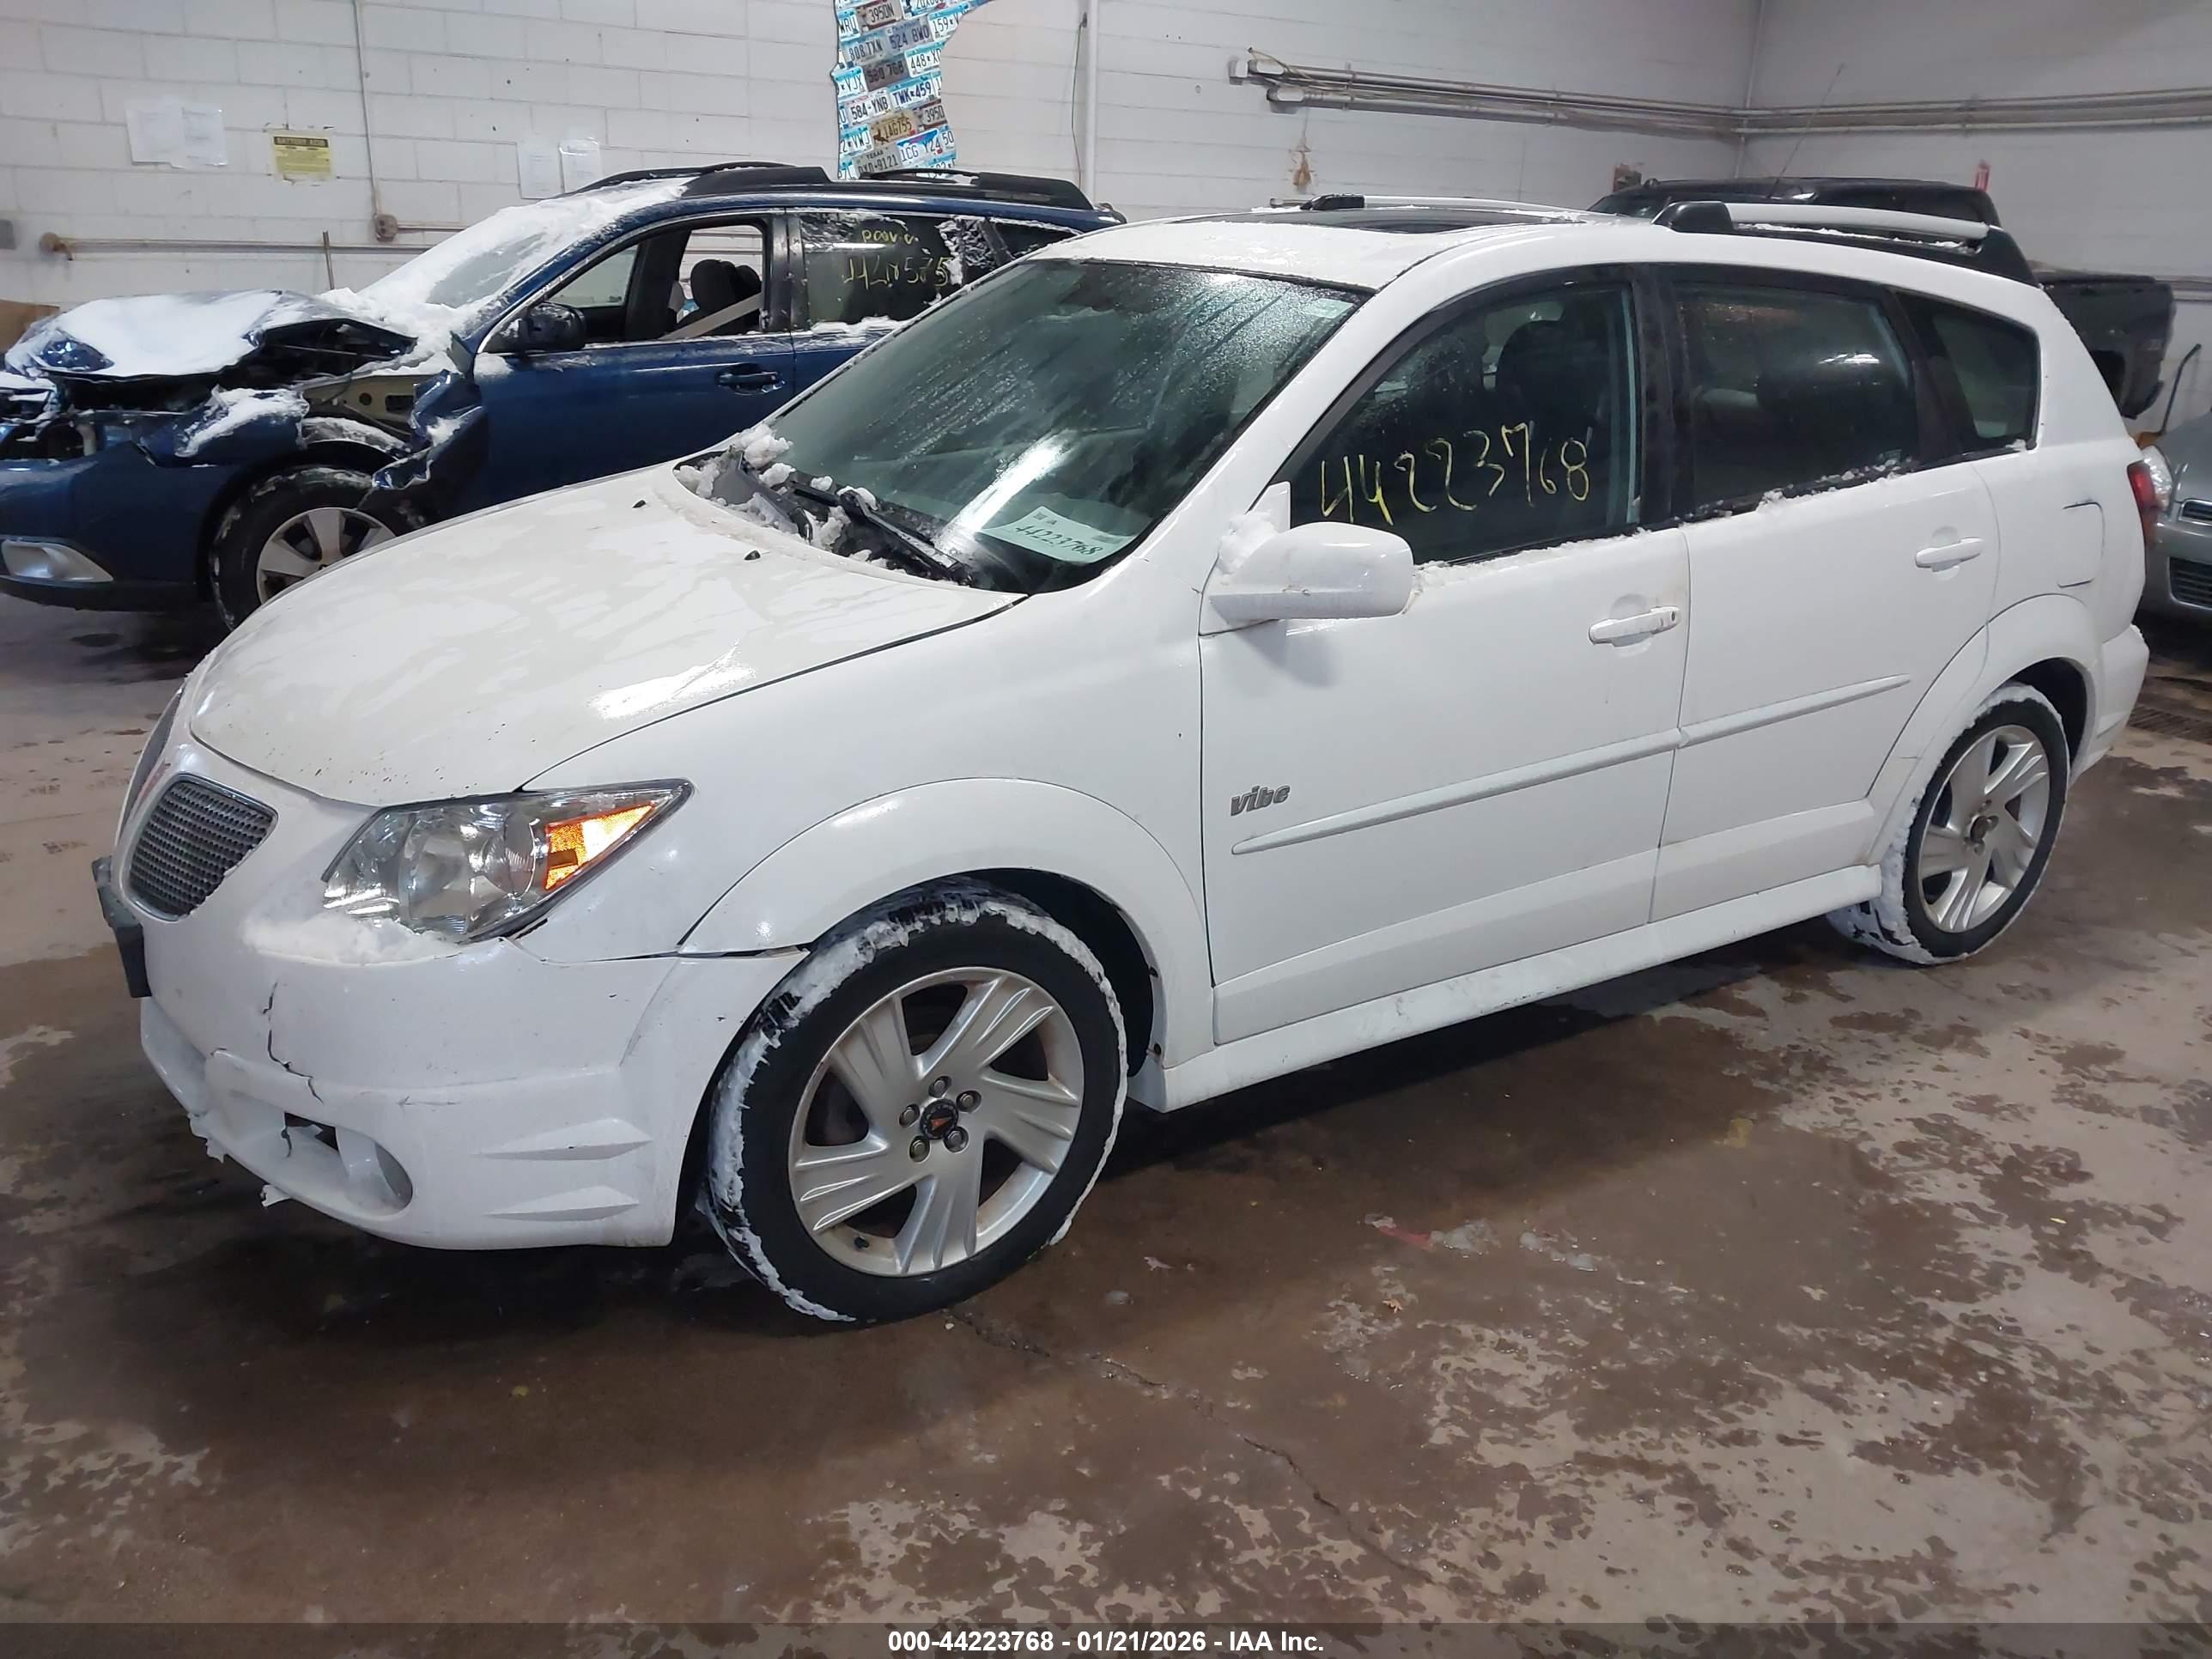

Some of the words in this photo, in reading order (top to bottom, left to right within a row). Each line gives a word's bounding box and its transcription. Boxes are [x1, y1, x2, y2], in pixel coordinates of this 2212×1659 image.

[911, 53, 927, 70] 448
[892, 88, 913, 106] TWK
[916, 82, 932, 98] 459
[1319, 420, 1590, 526] 44223768
[1230, 785, 1291, 816] vibe
